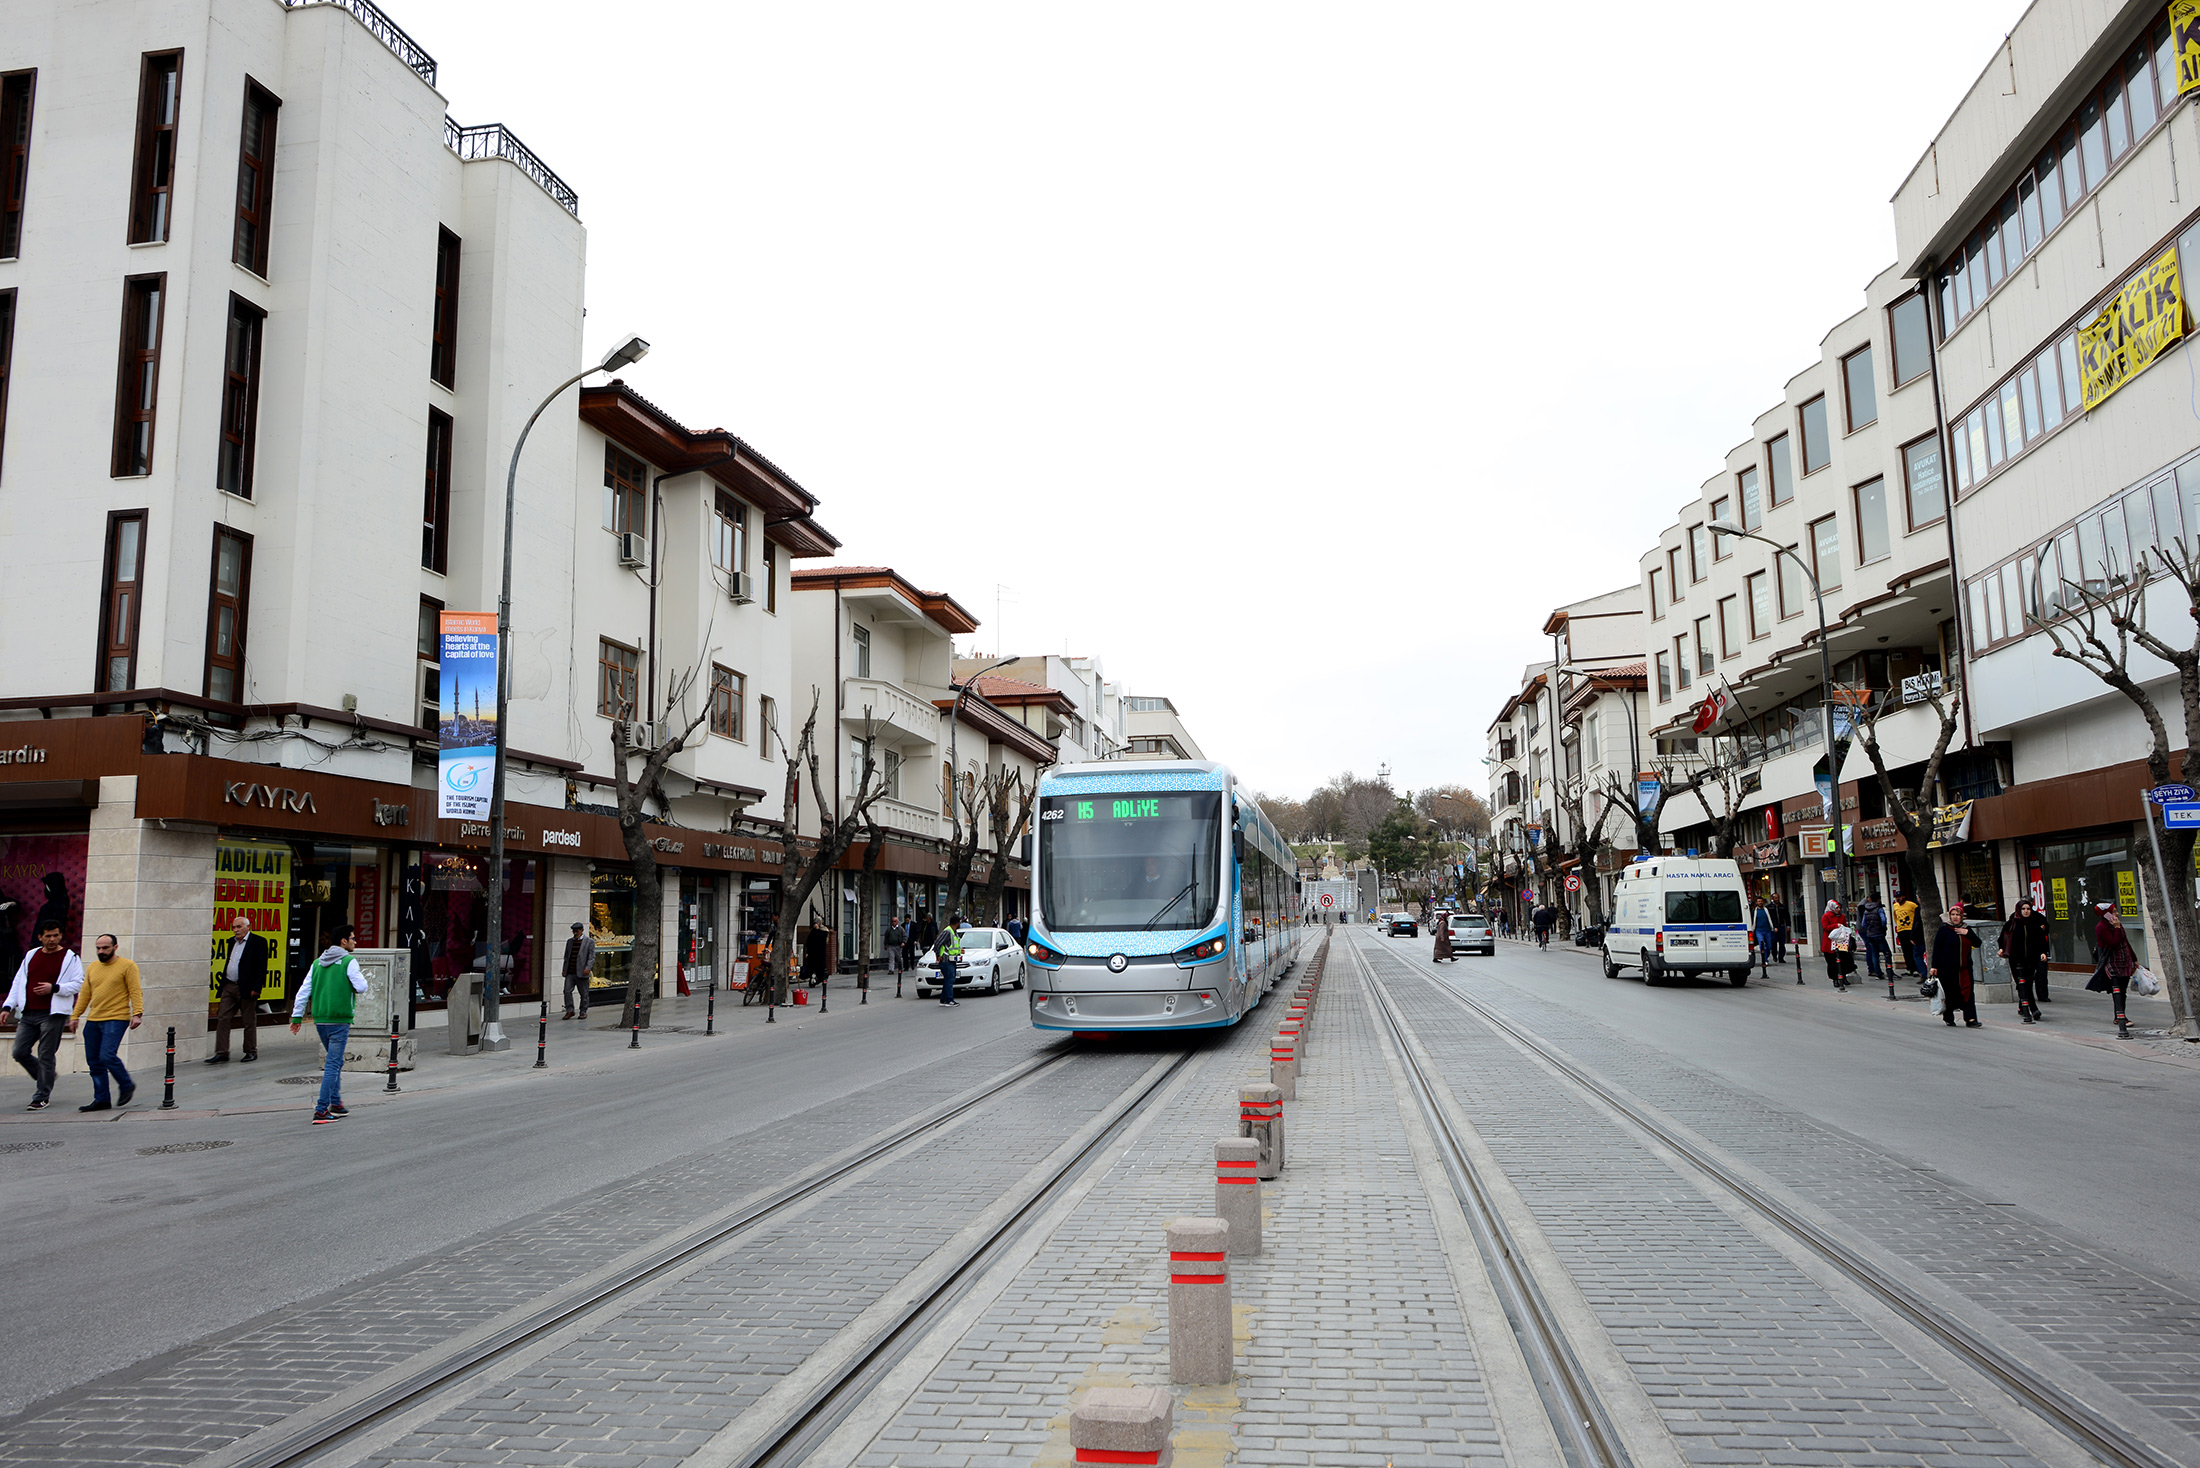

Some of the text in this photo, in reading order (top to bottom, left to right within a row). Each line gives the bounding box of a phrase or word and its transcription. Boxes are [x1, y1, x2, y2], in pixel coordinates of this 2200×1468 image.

[1913, 453, 1937, 472] AVUKAT
[445, 634, 479, 643] Believing
[445, 642, 469, 650] hearts
[445, 651, 470, 659] capital
[224, 780, 317, 814] KAYRA
[2154, 790, 2173, 798] ŞEYH
[1041, 809, 1064, 820] 4262
[1077, 799, 1159, 819] H5 ADLİYE
[461, 820, 525, 840] pierre ardin
[543, 829, 581, 847] pardesü
[3, 864, 46, 878] KAYRA
[2030, 880, 2045, 911] 50
[213, 907, 282, 931] ARRINA
